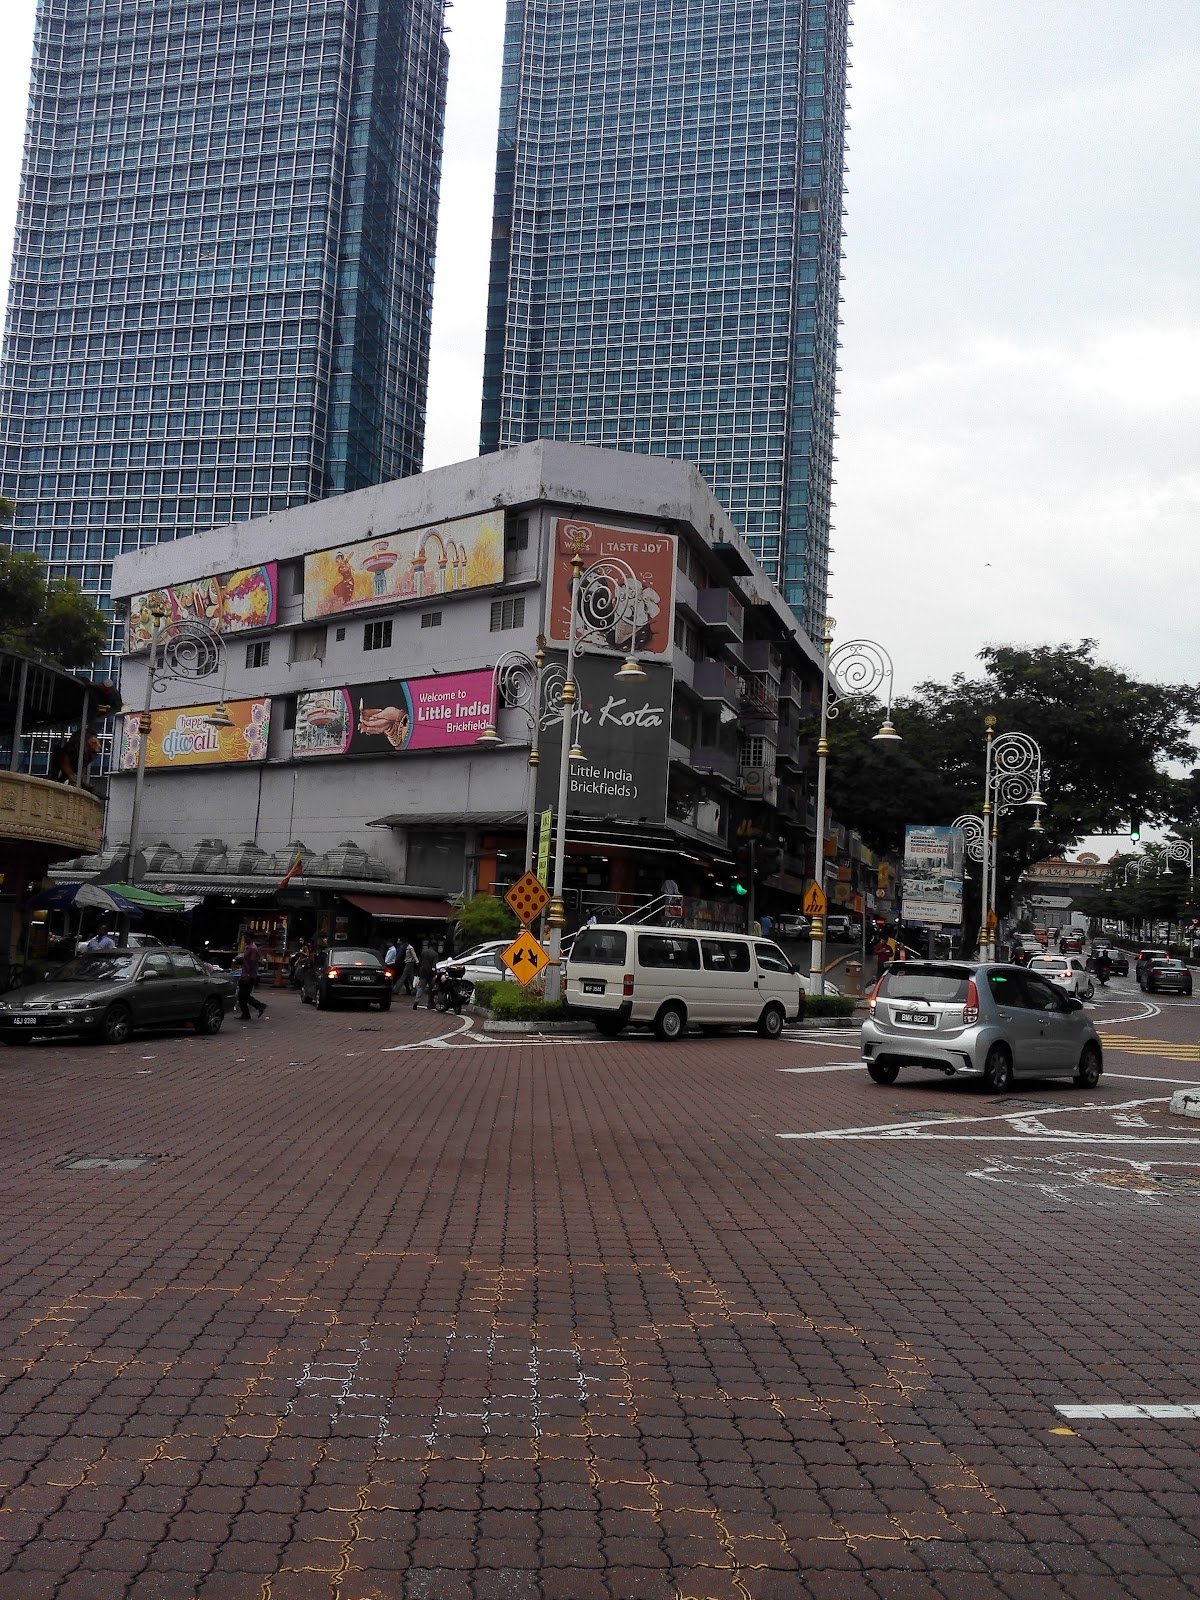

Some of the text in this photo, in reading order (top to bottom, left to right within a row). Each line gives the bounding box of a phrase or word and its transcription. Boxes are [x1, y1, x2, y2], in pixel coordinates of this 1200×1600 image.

[607, 541, 662, 554] TASTE JOY
[419, 690, 467, 703] Welcome to
[418, 701, 490, 721] Little India
[598, 695, 665, 728] Kota
[163, 727, 220, 758] diwali
[570, 764, 633, 782] Little India
[570, 779, 631, 798] Brickfields
[911, 846, 949, 855] BERSAMA
[1030, 866, 1076, 877] ELAMAT
